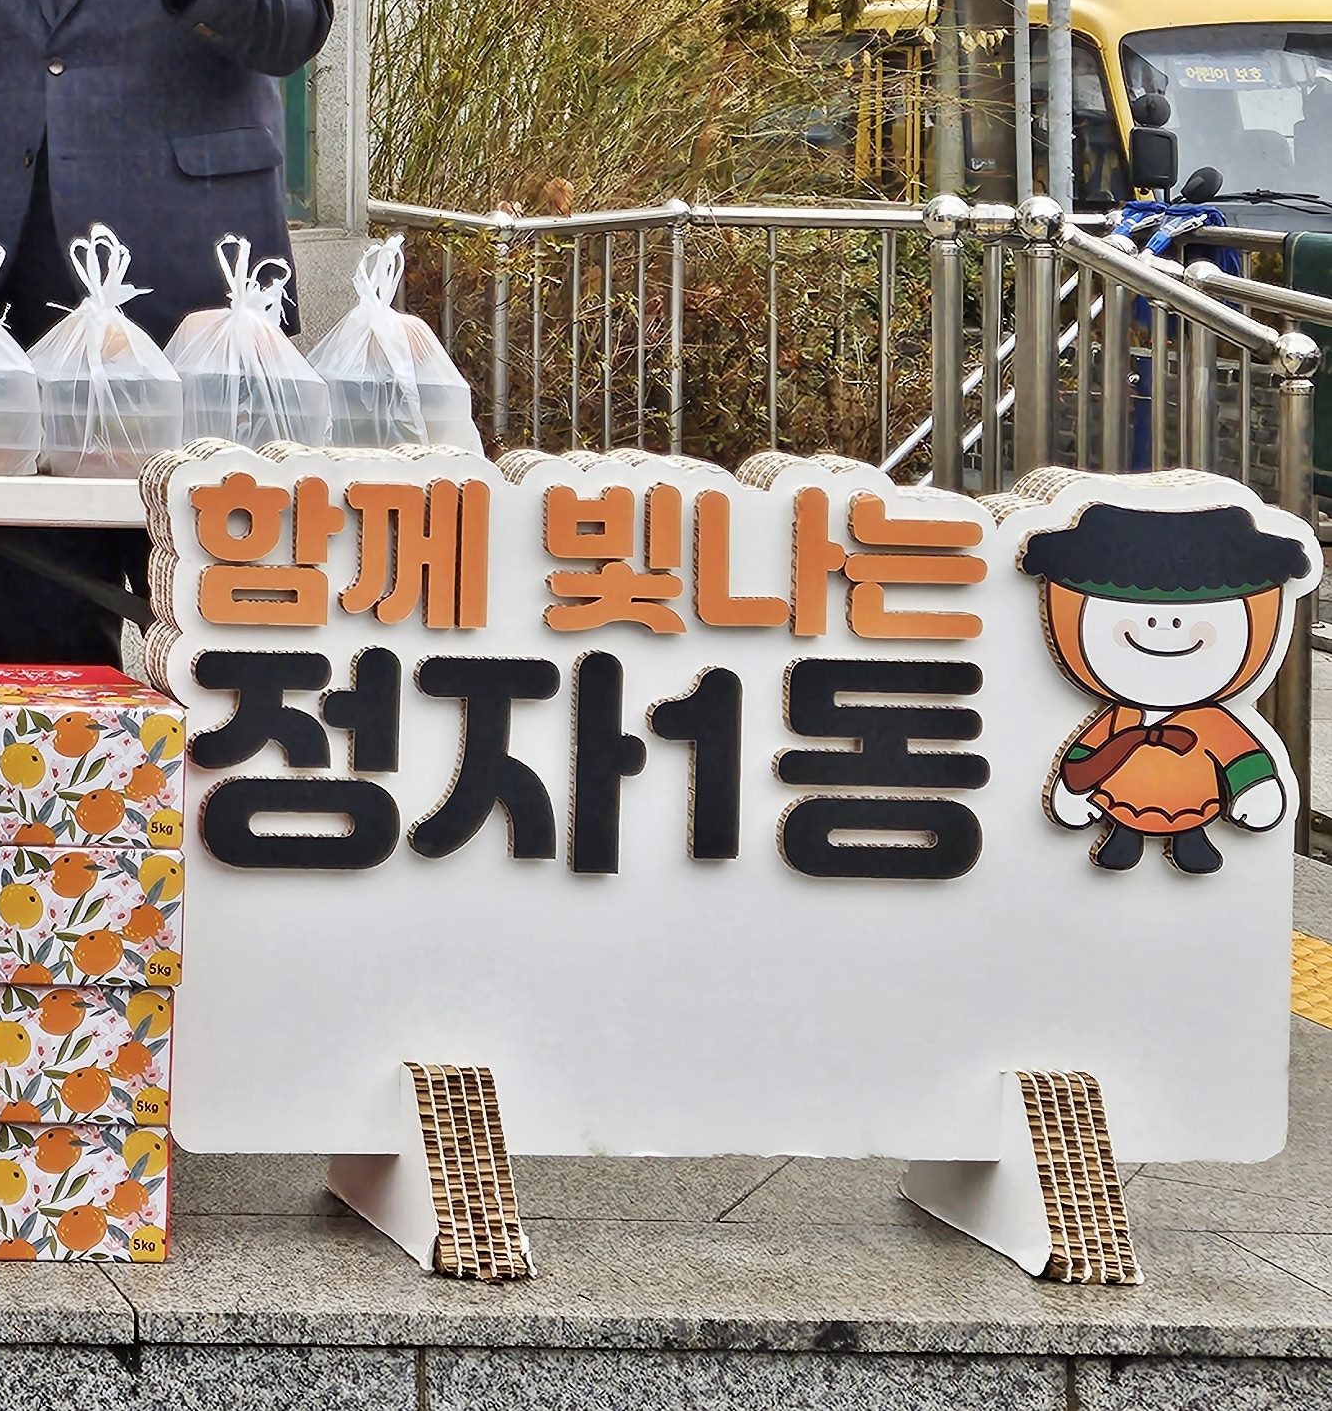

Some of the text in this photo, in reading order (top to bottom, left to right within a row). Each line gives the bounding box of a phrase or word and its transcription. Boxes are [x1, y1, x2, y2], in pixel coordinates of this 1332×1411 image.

[189, 471, 988, 642] 함께 빛나는
[189, 645, 990, 880] 정자1동
[151, 822, 174, 837] 5kg
[149, 962, 172, 978] 5kg
[136, 1099, 159, 1114] 5kg
[133, 1238, 156, 1253] 5kg
